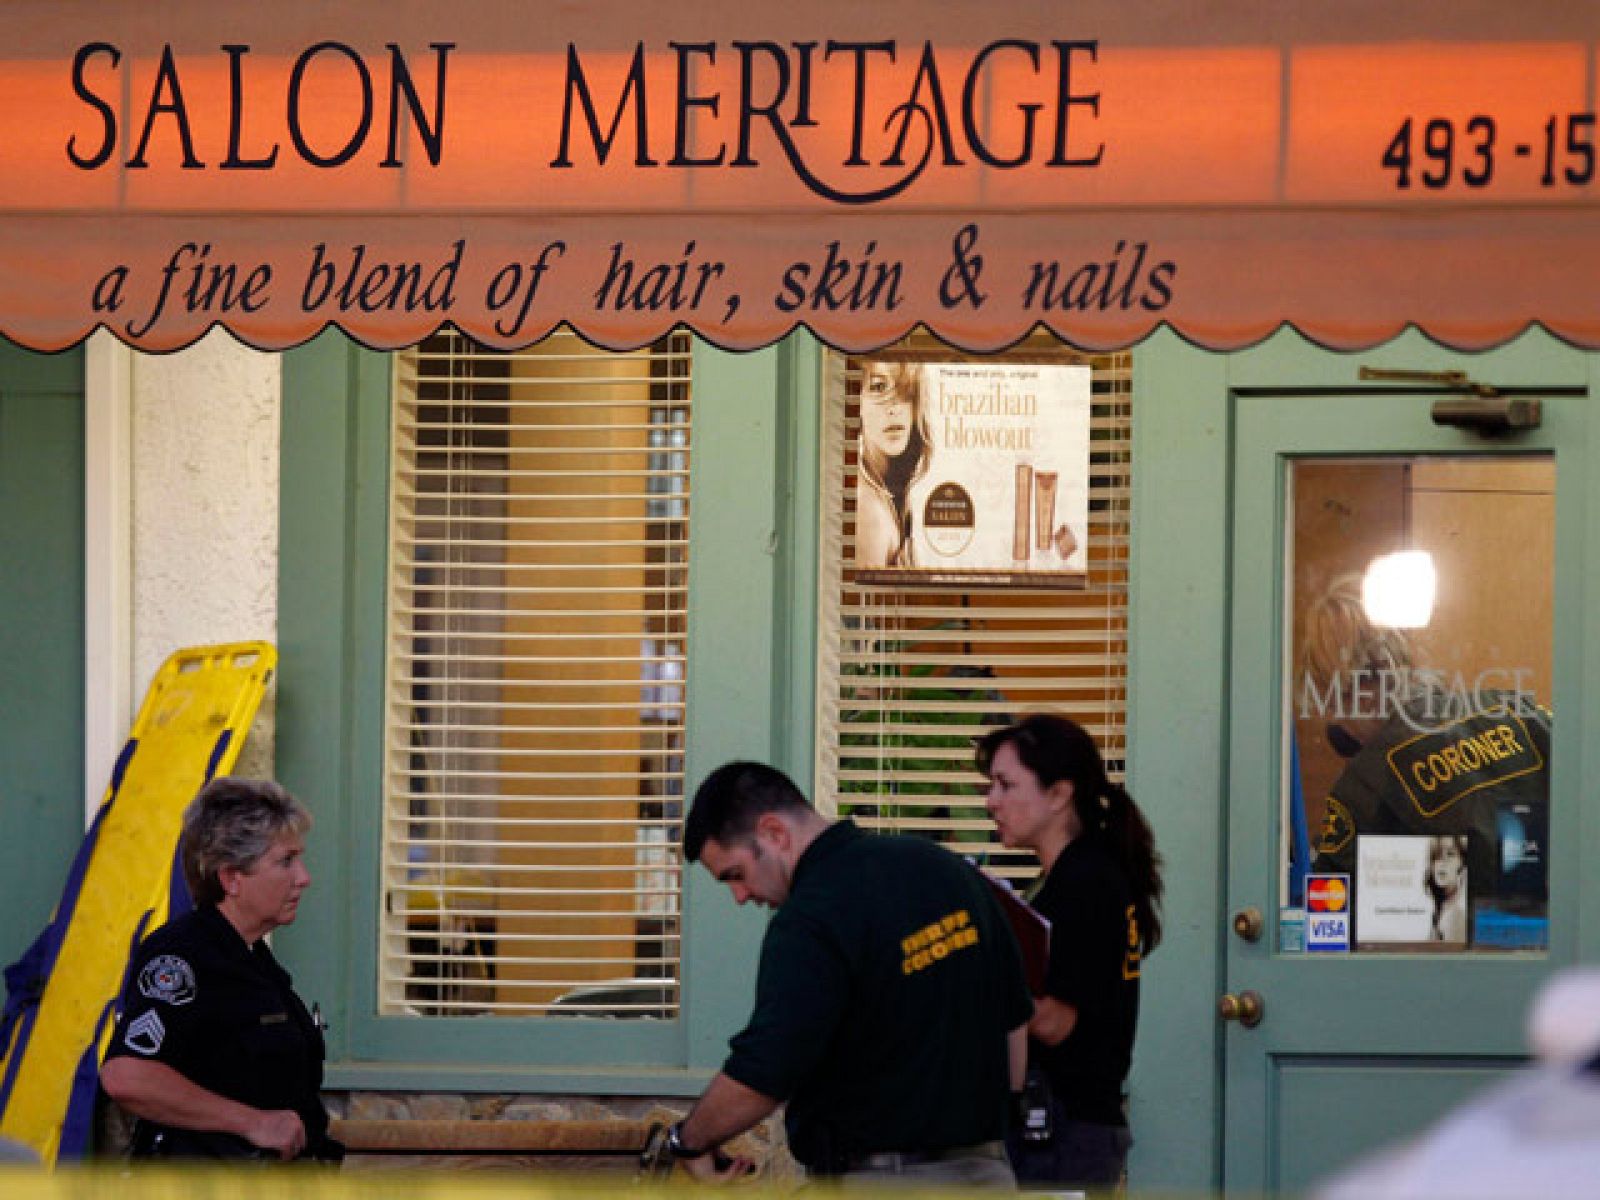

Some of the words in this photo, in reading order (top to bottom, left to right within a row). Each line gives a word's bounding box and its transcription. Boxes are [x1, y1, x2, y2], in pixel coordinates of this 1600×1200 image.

[67, 41, 455, 170] SALON
[550, 40, 1104, 204] MERITAGE
[92, 263, 130, 312] a
[125, 241, 272, 336] fine
[301, 239, 465, 312] blend
[486, 241, 566, 335] of
[594, 240, 742, 325] hair,
[775, 240, 903, 312] skin
[938, 224, 987, 310] &
[1023, 240, 1176, 311] nails
[939, 382, 1038, 415] brazilian
[944, 416, 1032, 449] blowout
[1297, 667, 1537, 733] MERITAGE
[1411, 723, 1524, 791] CORONER
